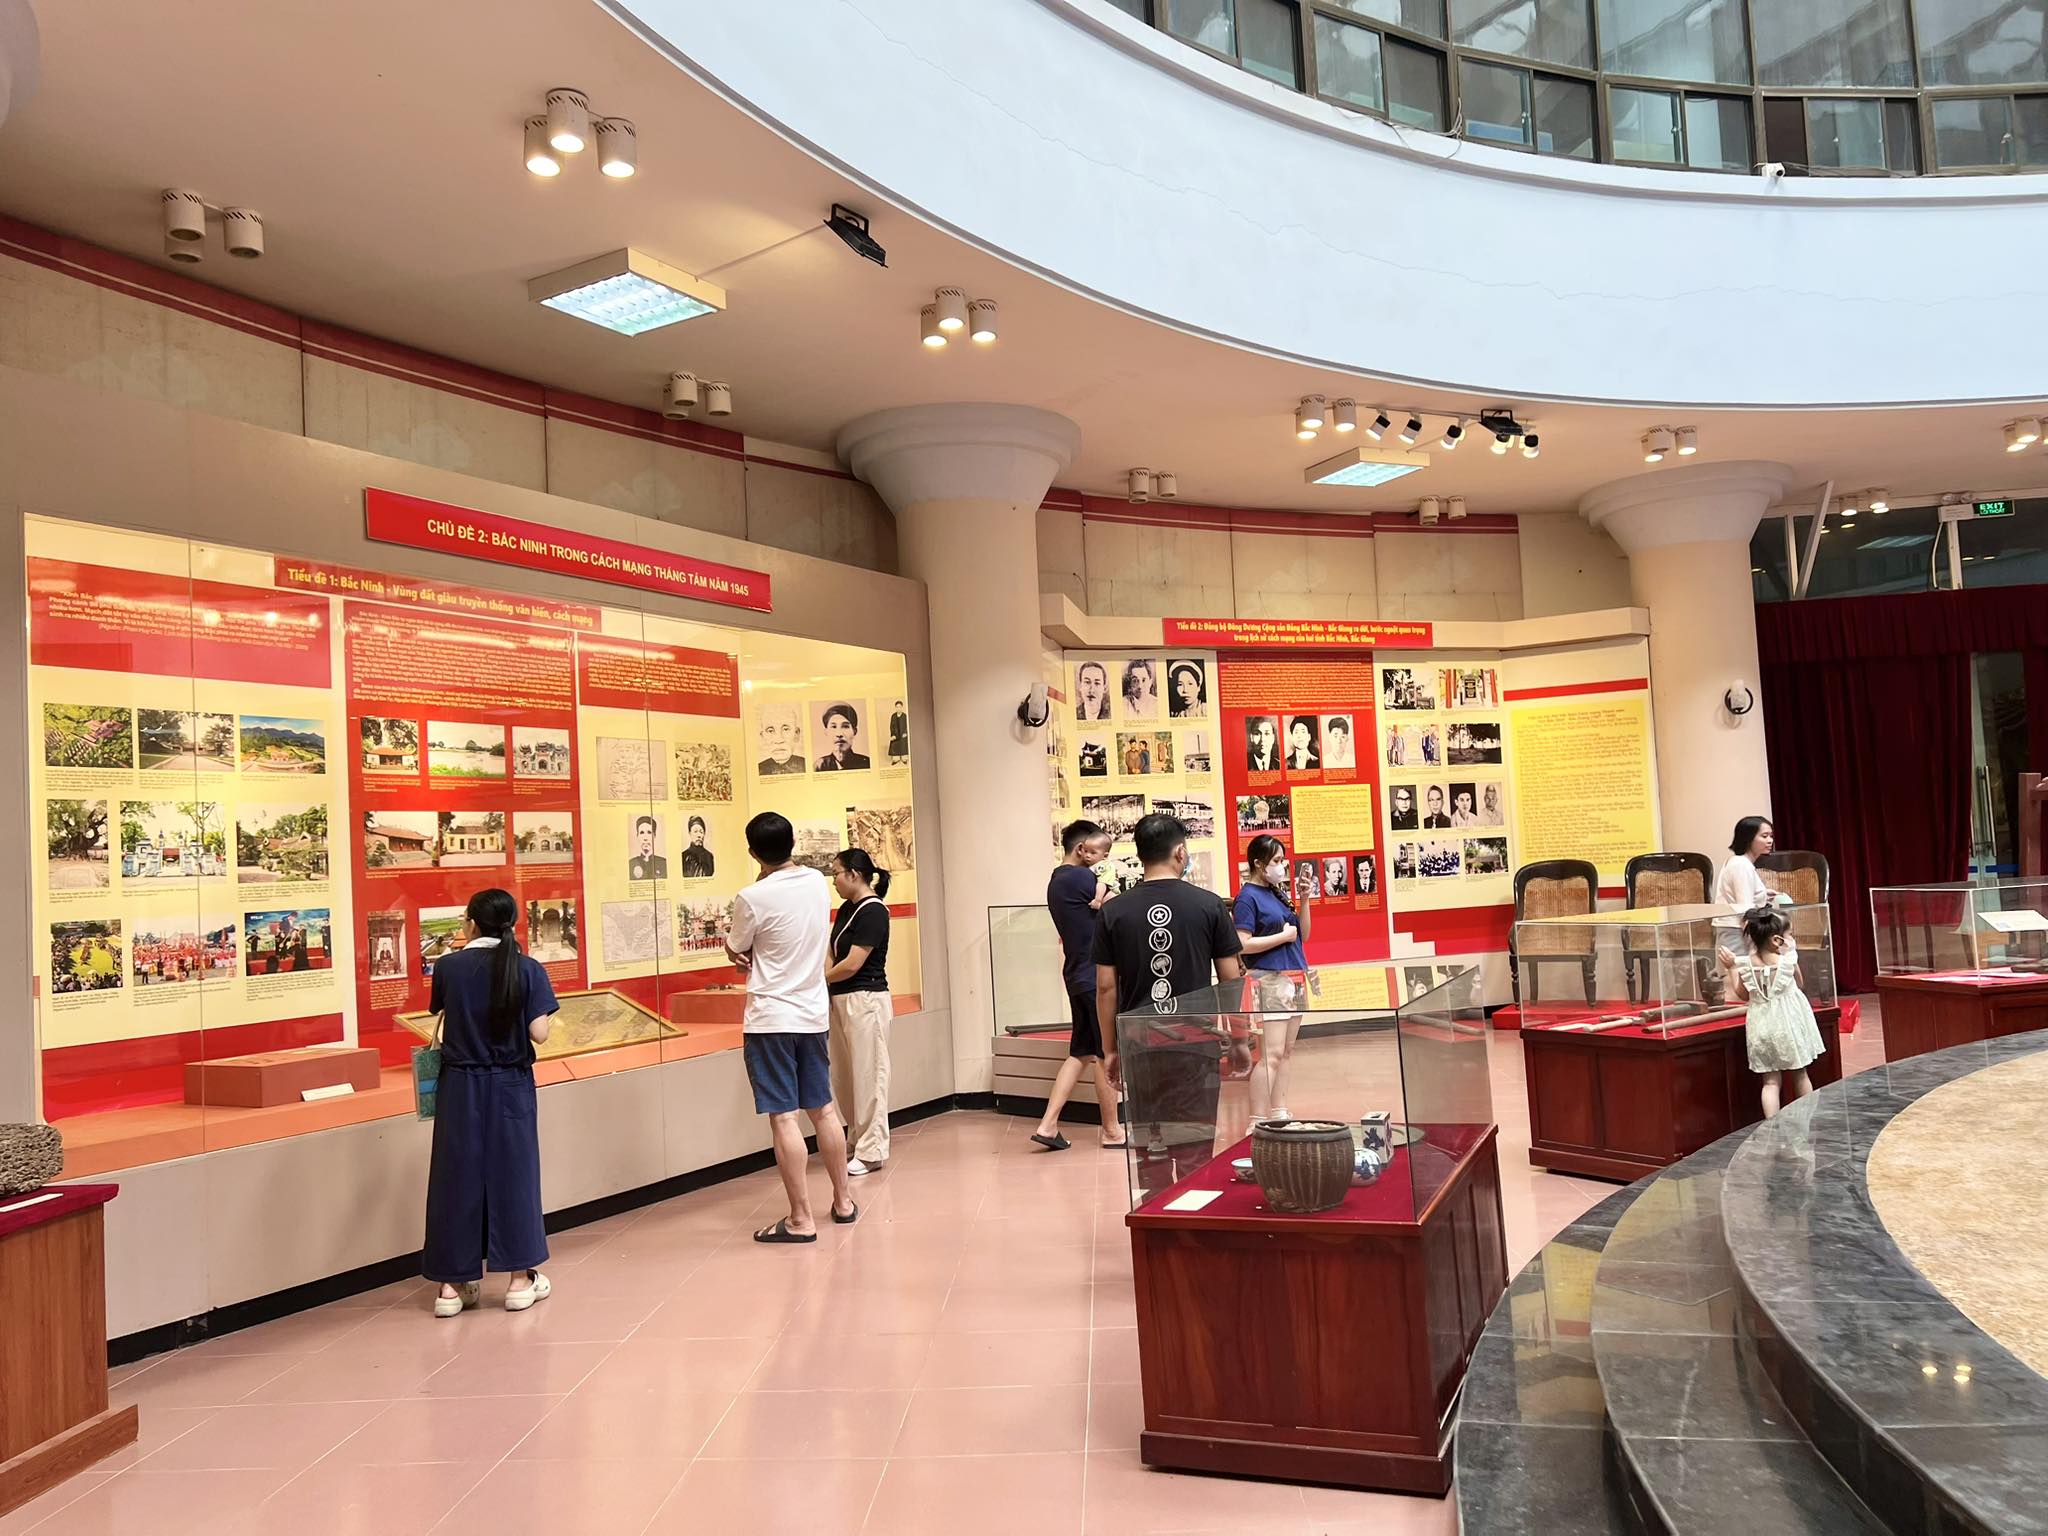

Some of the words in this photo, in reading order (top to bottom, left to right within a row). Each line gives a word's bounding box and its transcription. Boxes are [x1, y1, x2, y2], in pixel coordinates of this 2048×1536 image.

[1979, 502, 2004, 510] EXIT
[427, 519, 454, 536] CHỦ
[458, 525, 475, 541] ĐỀ
[478, 530, 488, 544] 2:
[492, 532, 517, 549] BẮC
[520, 538, 547, 555] NINH
[550, 544, 588, 563] TRONG
[591, 552, 620, 570] CÁCH
[622, 560, 652, 576] MẠNG
[654, 565, 687, 583] THÁNG
[688, 572, 707, 588] TÁM
[709, 576, 729, 593] NĂM
[730, 583, 749, 596] 1945
[287, 568, 311, 583] Tiểu
[314, 571, 327, 585] đề
[329, 575, 338, 586] 1:
[340, 575, 358, 590] Bắc
[361, 580, 384, 594] Ninh
[393, 584, 417, 601] Vùng
[420, 588, 435, 601] đất
[437, 592, 457, 604] giàu
[459, 596, 487, 610] truyền
[489, 600, 513, 615] thống
[515, 604, 530, 615] văn
[532, 606, 551, 620] hiến,
[553, 610, 570, 622] cách
[572, 615, 593, 627] mạng
